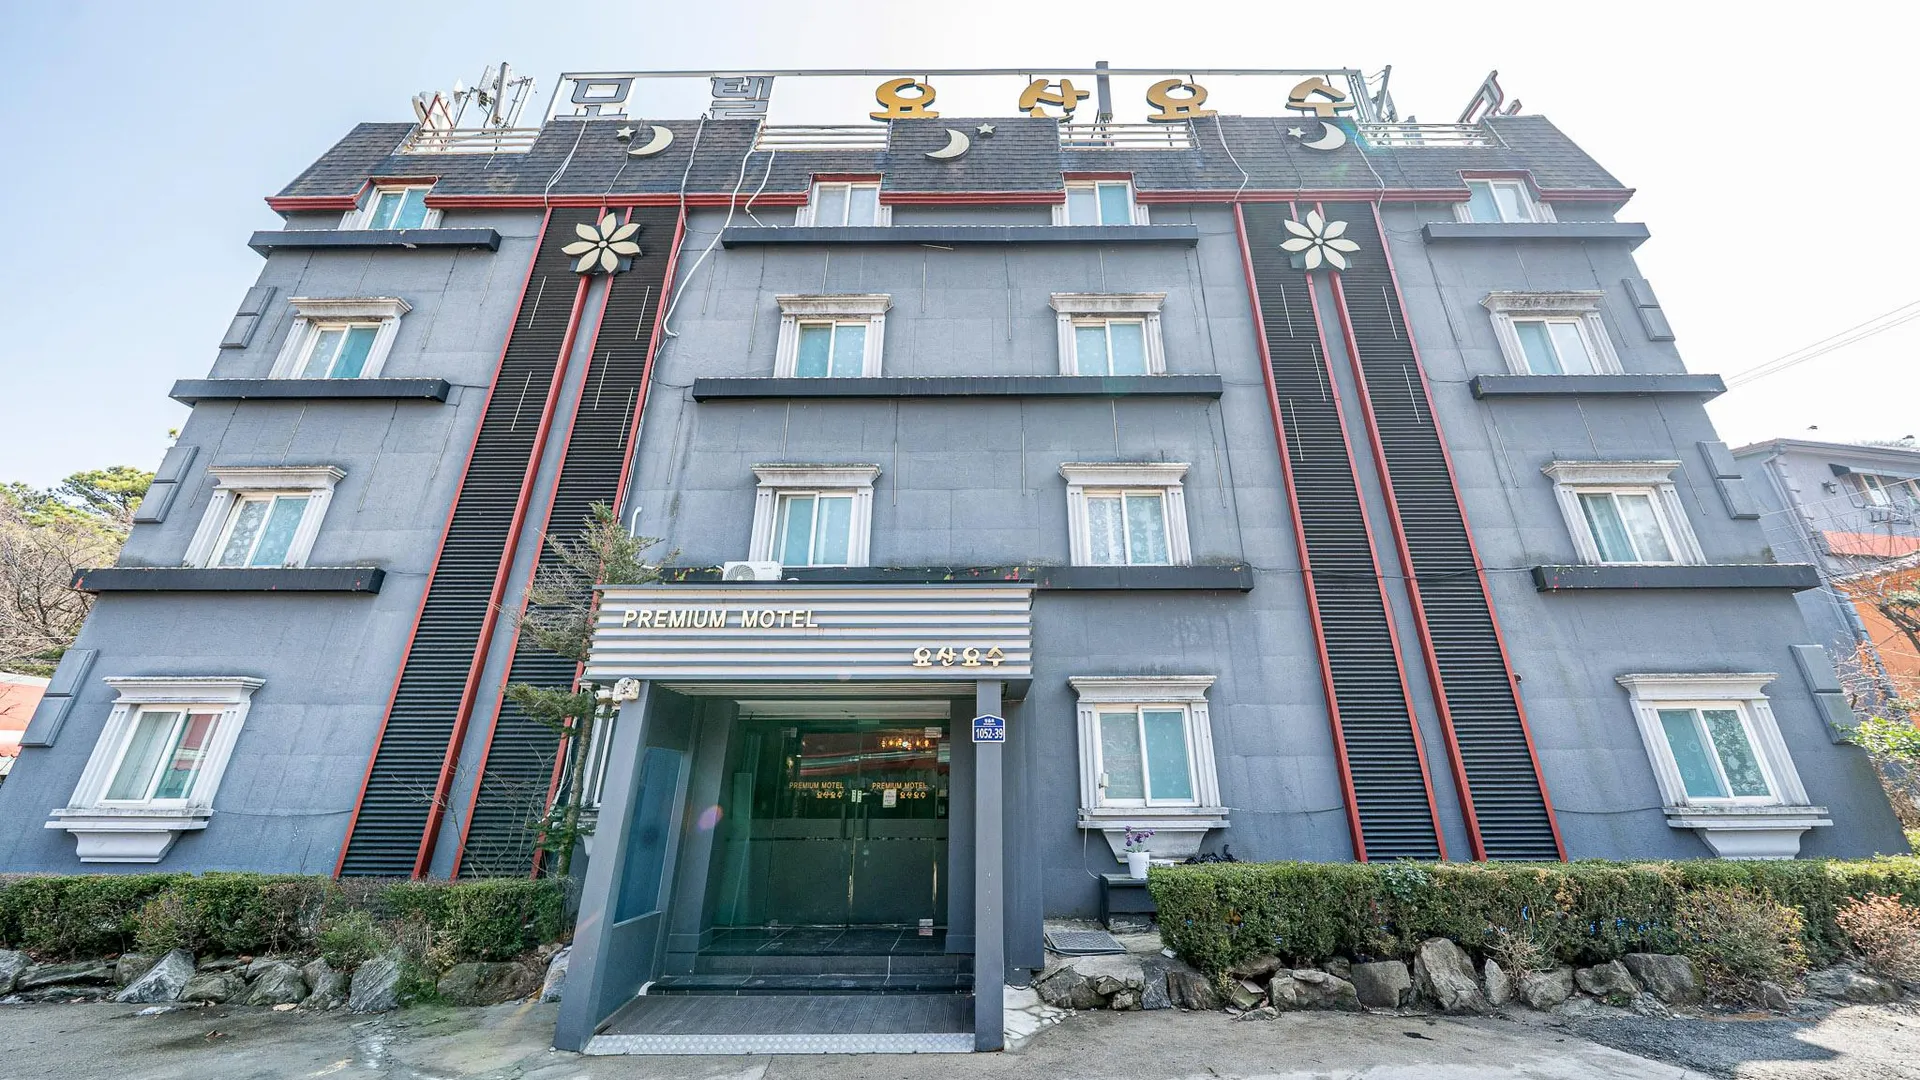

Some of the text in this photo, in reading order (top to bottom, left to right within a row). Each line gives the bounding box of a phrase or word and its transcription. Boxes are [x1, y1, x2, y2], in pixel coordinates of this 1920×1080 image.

[554, 76, 1356, 123] 모텔 요산요수
[622, 609, 819, 629] PREMIUM MOTEL
[912, 644, 1006, 668] 요산요수
[975, 727, 1003, 740] 1052-39
[789, 781, 845, 790] PREMIUM MOTEL
[872, 782, 928, 790] PREMIUM MOTEL
